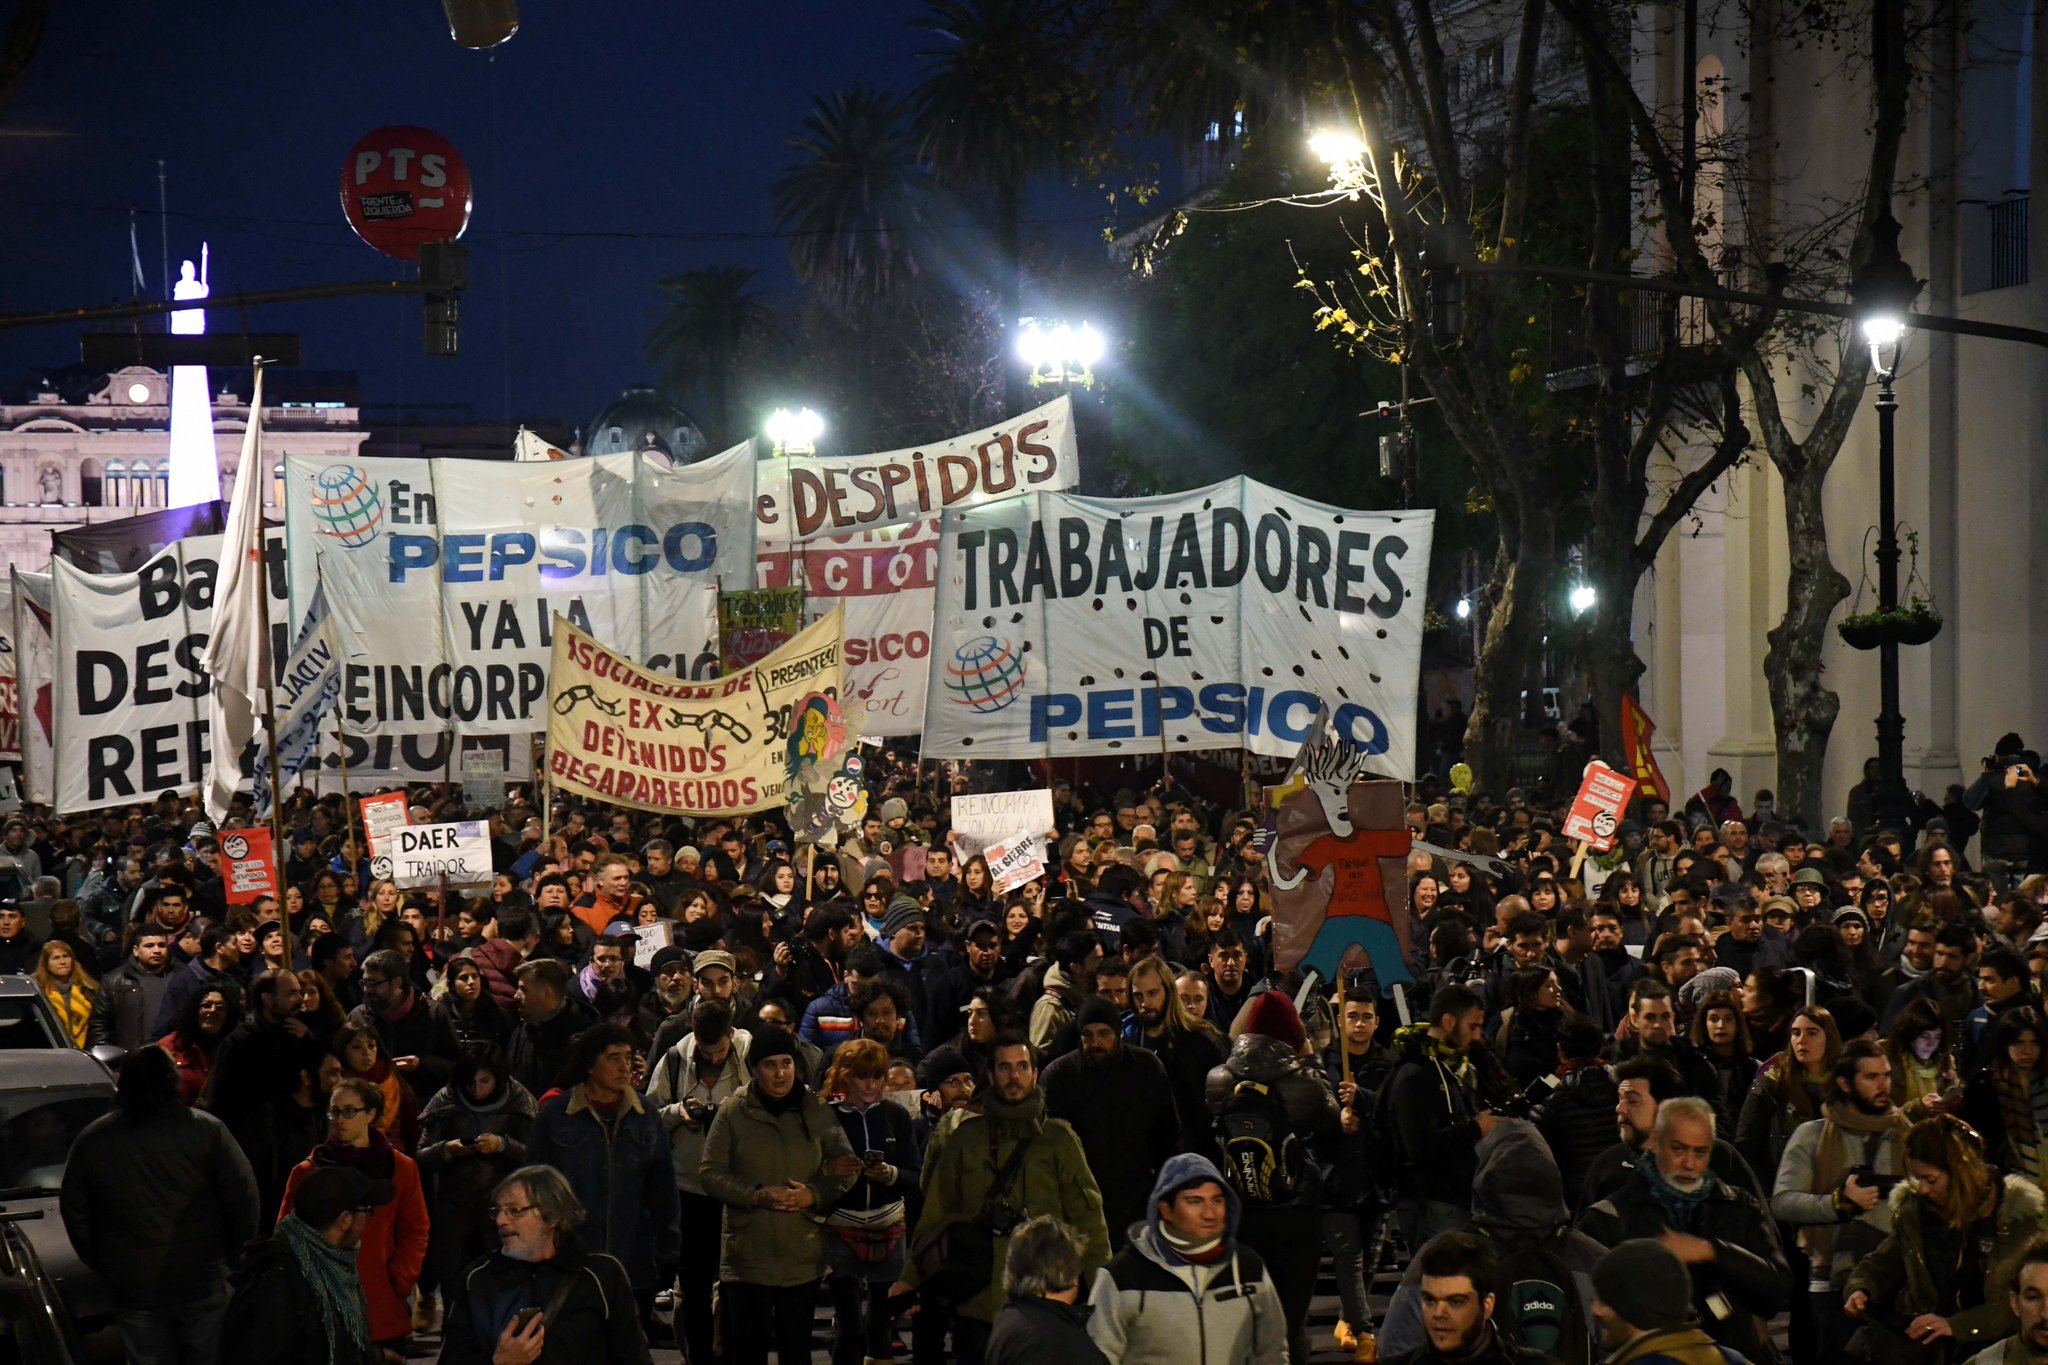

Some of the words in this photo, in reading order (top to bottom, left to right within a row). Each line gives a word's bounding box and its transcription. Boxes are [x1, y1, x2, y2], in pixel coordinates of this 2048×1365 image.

[355, 148, 447, 188] PTS
[388, 479, 437, 525] En
[388, 521, 718, 583] PEPSICO
[957, 507, 1410, 620] TRABAJADORES
[461, 599, 526, 650] YA
[1144, 615, 1193, 661] DE
[843, 630, 930, 667] SICO
[722, 670, 753, 698] DE
[628, 698, 664, 731] EX
[1029, 682, 1390, 756] PEPSICO
[582, 719, 727, 773] DETENIDOS
[551, 750, 759, 809] DESAPARECIDOS
[401, 827, 460, 853] DAER
